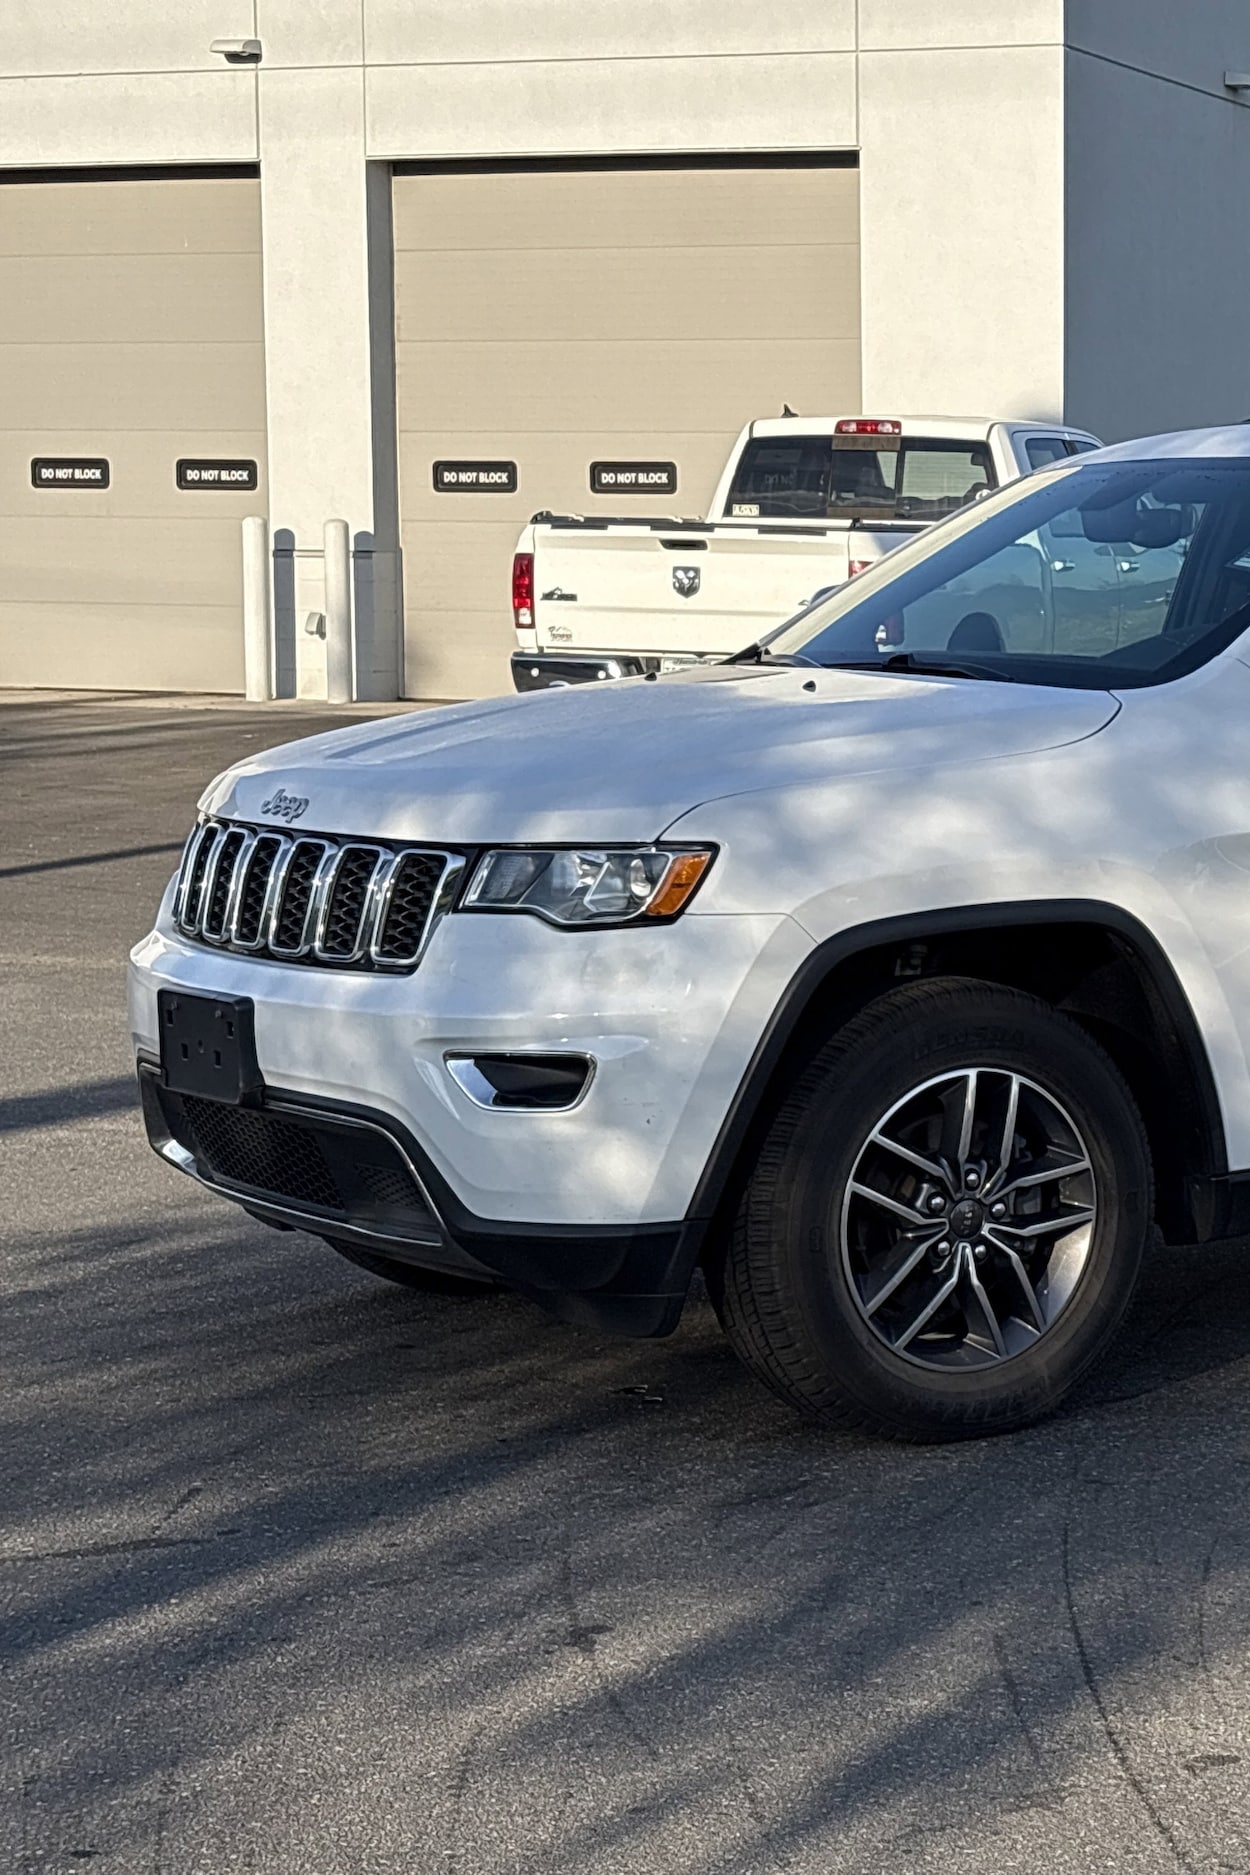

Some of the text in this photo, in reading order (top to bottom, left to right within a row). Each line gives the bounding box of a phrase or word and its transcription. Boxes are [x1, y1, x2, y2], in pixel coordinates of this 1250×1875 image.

[41, 468, 102, 480] DO NOT BLOCK
[186, 470, 249, 481] DO NOT BLOCK
[443, 471, 508, 483] DO NOT BLOCK
[601, 472, 668, 484] DO NOT BLOCK
[261, 788, 310, 824] Jeep
